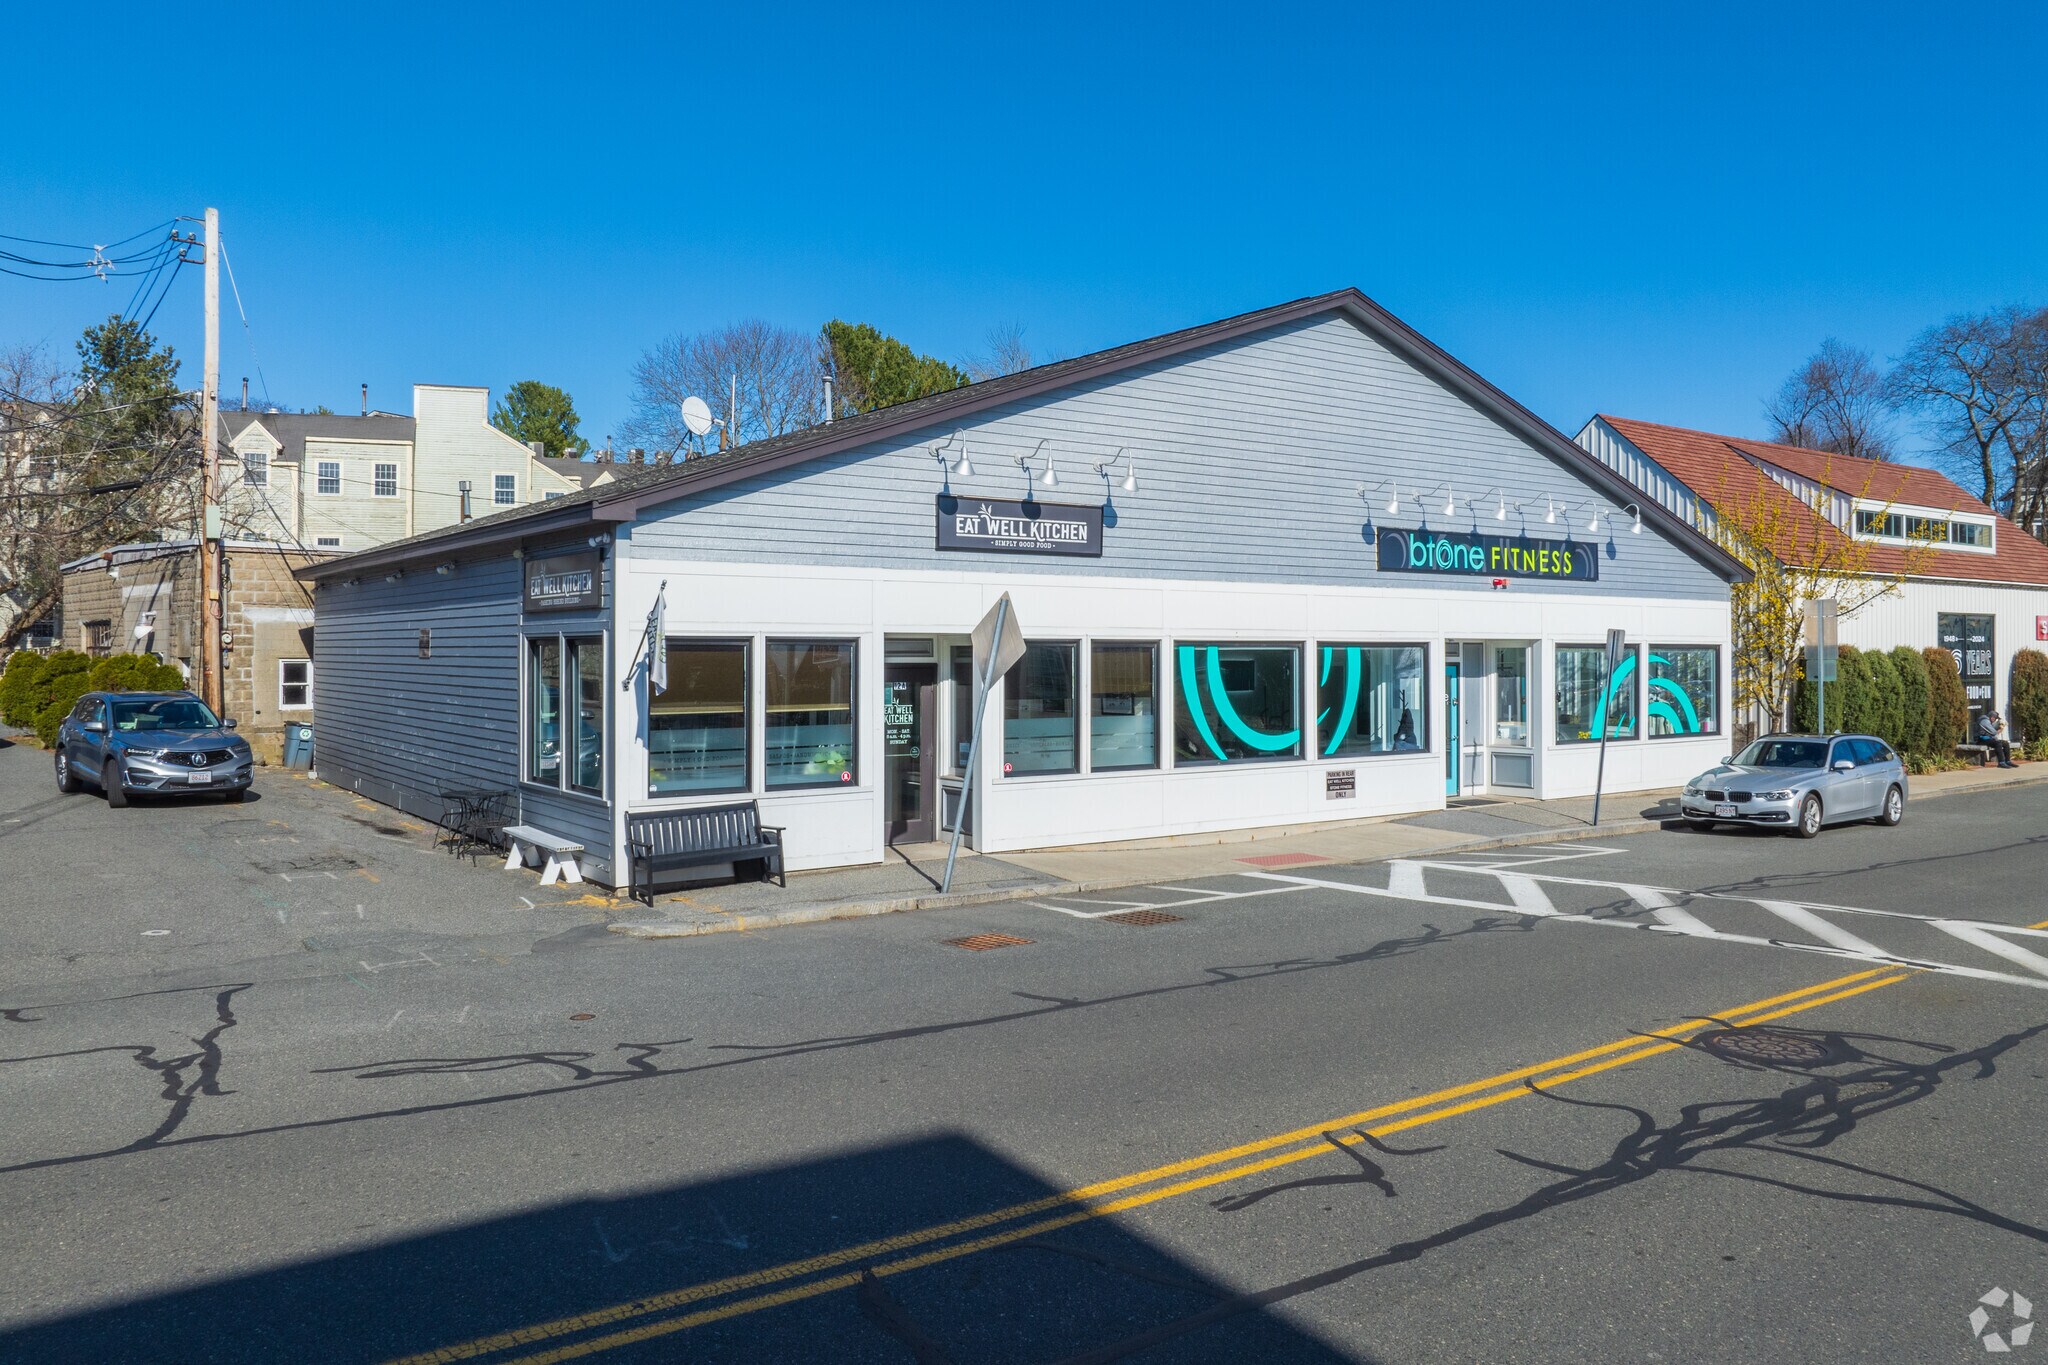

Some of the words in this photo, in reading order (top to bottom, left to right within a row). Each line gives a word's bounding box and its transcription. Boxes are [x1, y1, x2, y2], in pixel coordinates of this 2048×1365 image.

[956, 517, 980, 534] EAT
[981, 515, 1027, 537] WELL
[1030, 523, 1088, 542] KITCHEN
[995, 540, 1018, 548] SIMPLY
[1492, 546, 1573, 574] FITNESS
[531, 579, 541, 596] EAT
[541, 575, 561, 594] WELL
[562, 573, 592, 597] KITCHEN
[1972, 635, 1985, 643] 2024
[1966, 649, 1992, 676] YEARS
[1966, 685, 1979, 699] FOOD
[894, 705, 913, 714] WELL
[884, 714, 913, 725] KITCHEN
